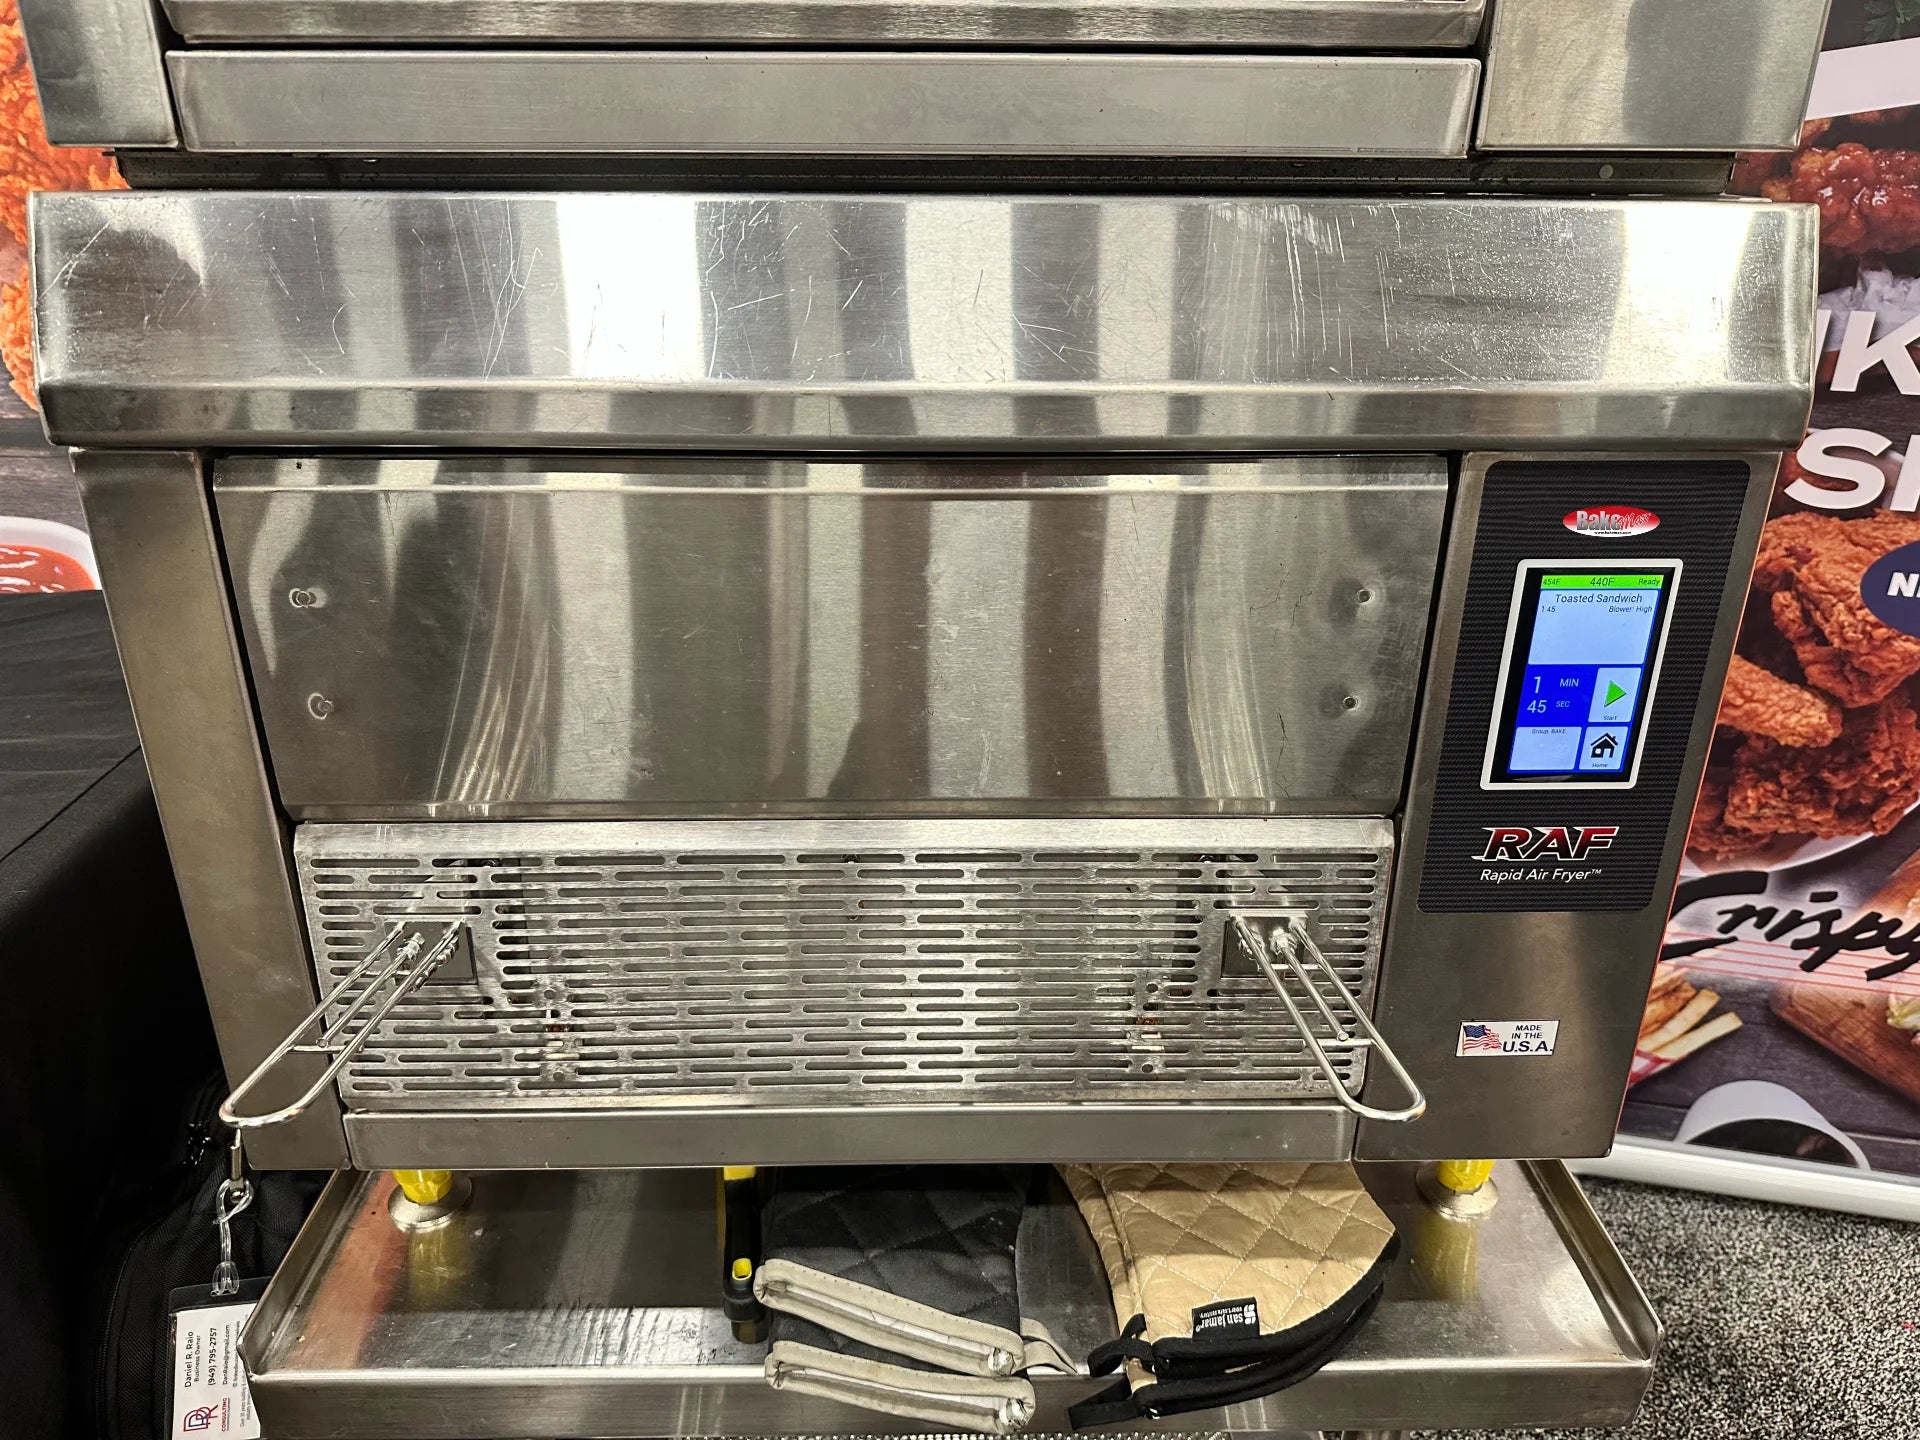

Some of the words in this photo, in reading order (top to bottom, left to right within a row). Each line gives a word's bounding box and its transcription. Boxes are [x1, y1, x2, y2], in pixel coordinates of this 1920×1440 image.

[1542, 578, 1560, 586] 454F
[1590, 577, 1614, 587] 440F
[1638, 578, 1660, 586] Ready
[1887, 571, 1920, 598] N
[1555, 594, 1594, 603] Toasted
[1596, 593, 1643, 603] Sandwich
[1636, 605, 1652, 614] High
[1533, 676, 1541, 694] 1
[1559, 678, 1579, 687] MIN
[1526, 699, 1547, 714] 45
[1555, 700, 1570, 708] SEC
[1471, 826, 1620, 861] RAF
[1480, 868, 1524, 884] Rapid
[1525, 868, 1548, 881] Air
[1502, 1041, 1553, 1052] U.S.A.
[1226, 1313, 1243, 1324] san
[186, 1331, 194, 1350] Raio
[208, 1327, 217, 1363] 795-2757
[186, 1351, 192, 1360] R.
[222, 1324, 230, 1385] DanRaio@gmail.com
[184, 1362, 192, 1388] Daniel
[207, 1365, 217, 1386] (949)
